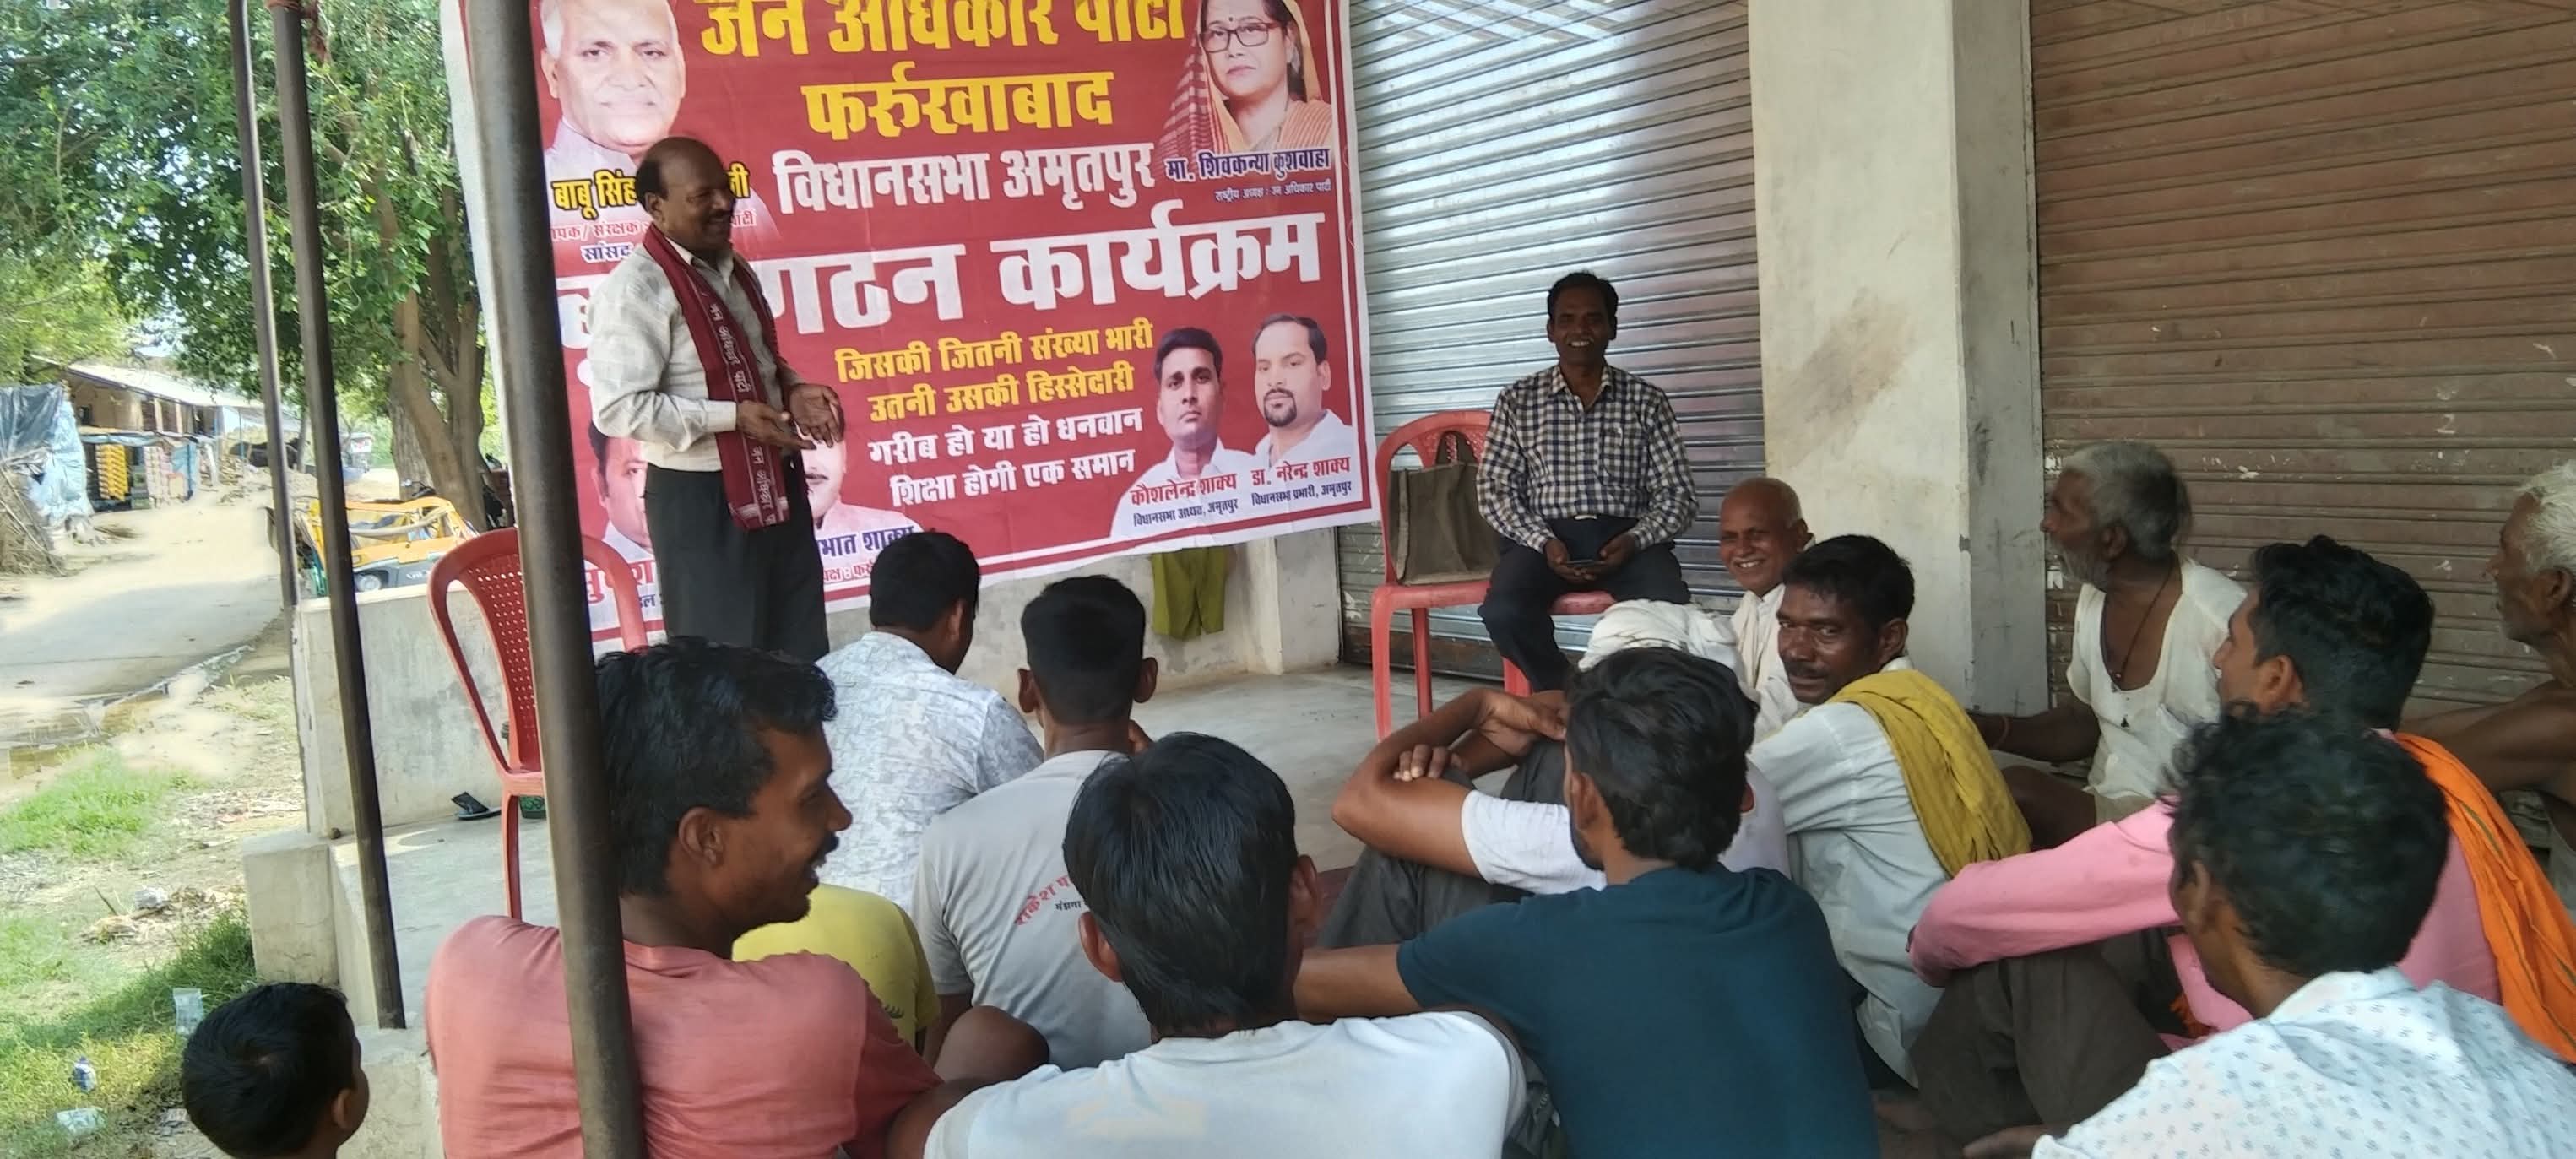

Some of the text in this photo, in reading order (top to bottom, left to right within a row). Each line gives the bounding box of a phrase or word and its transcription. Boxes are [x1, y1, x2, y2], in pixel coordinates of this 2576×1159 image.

[800, 61, 1114, 141] फर्रुखाबाद
[772, 149, 990, 214] विधानसभा
[1001, 143, 1156, 210] अमृतपुर
[1165, 147, 1331, 182] मा. शिवकन्या कुशवाहा
[1284, 182, 1315, 196] अधिकार
[551, 169, 637, 220] बाबू सिंह
[990, 198, 1326, 311] कार्यक्रम
[835, 317, 1154, 384] जिसकी जितनी संख्या भारी
[867, 360, 1136, 423] उतनी उसकी हिस्सेदारी
[868, 406, 1144, 466] गरीब हो या हो धनवान
[889, 448, 1136, 508] शिक्षा होगी एक समान
[1130, 473, 1237, 506] कौशलेन्द्र शाक्य
[1251, 456, 1351, 487] डा. नरेन्द्र शाक्य
[1251, 490, 1292, 507] विधानसभा
[1321, 480, 1353, 498] अमृतपुर
[1133, 510, 1177, 528] विधानसभा
[1207, 499, 1239, 517] अमृतपुर
[817, 533, 857, 557] भात
